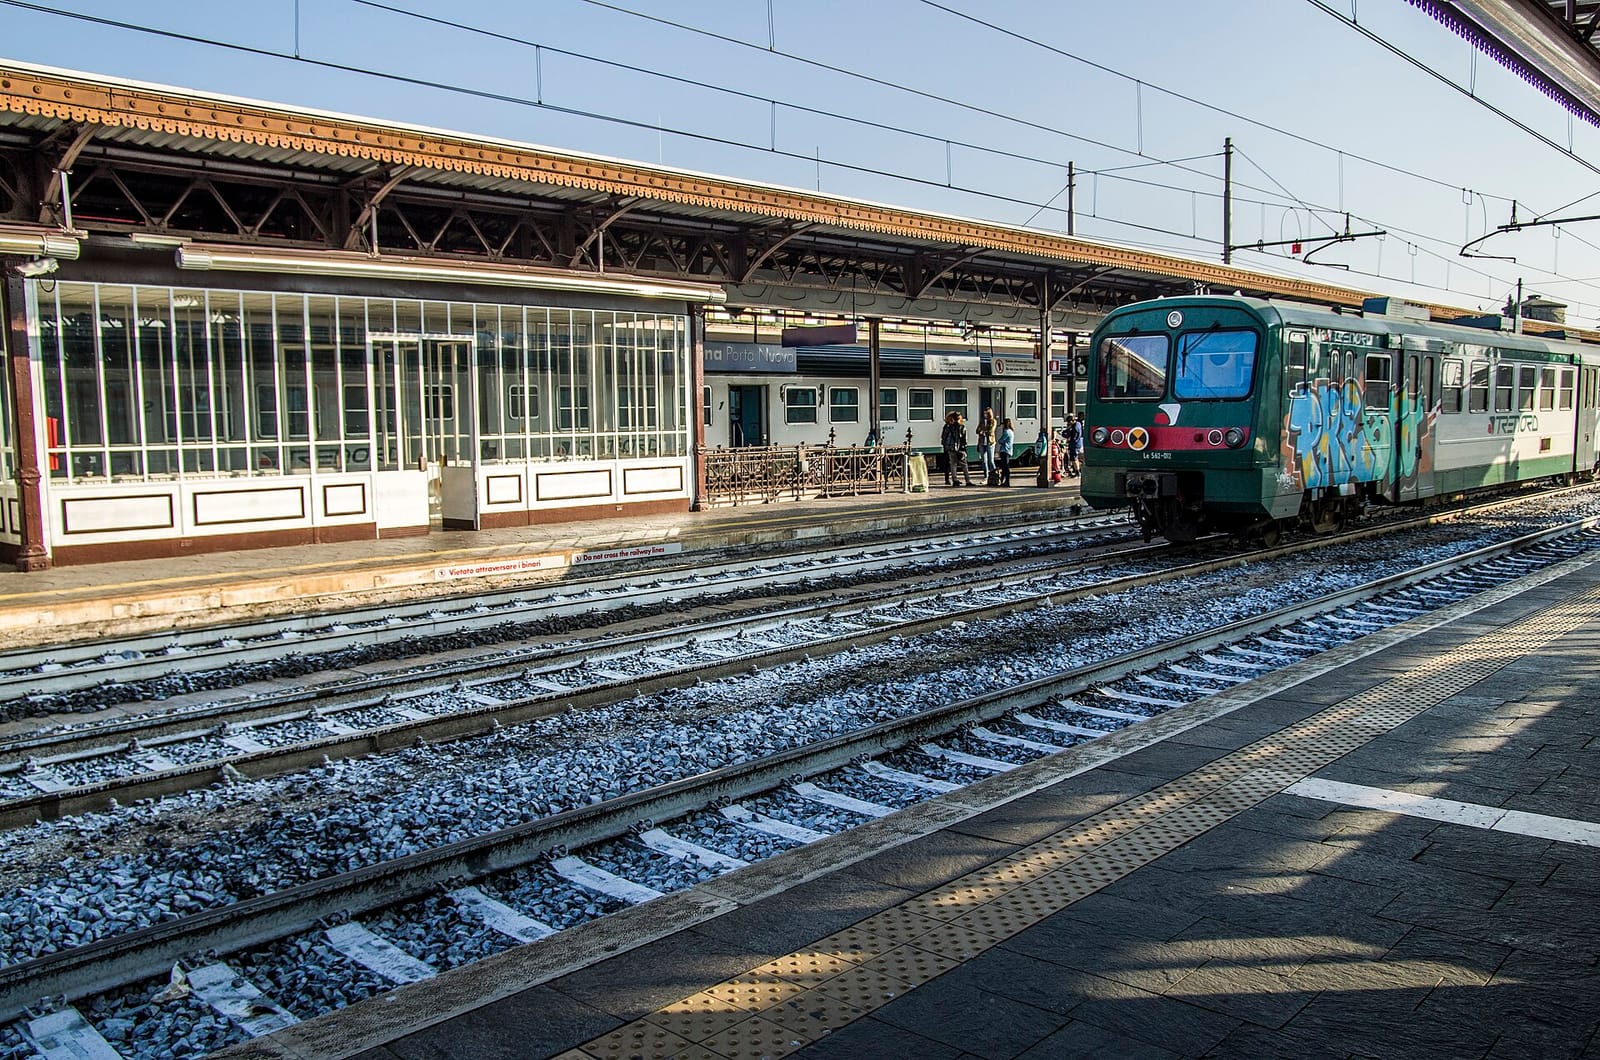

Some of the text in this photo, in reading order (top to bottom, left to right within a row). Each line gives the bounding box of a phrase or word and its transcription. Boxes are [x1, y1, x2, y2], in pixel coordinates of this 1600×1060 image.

[726, 345, 754, 362] Porta
[758, 347, 794, 363] Nuova
[593, 552, 603, 560] not
[629, 548, 652, 557] railway
[651, 546, 665, 554] lines
[448, 568, 474, 576] Vietato
[475, 563, 517, 573] attraversare
[521, 559, 541, 568] binari
